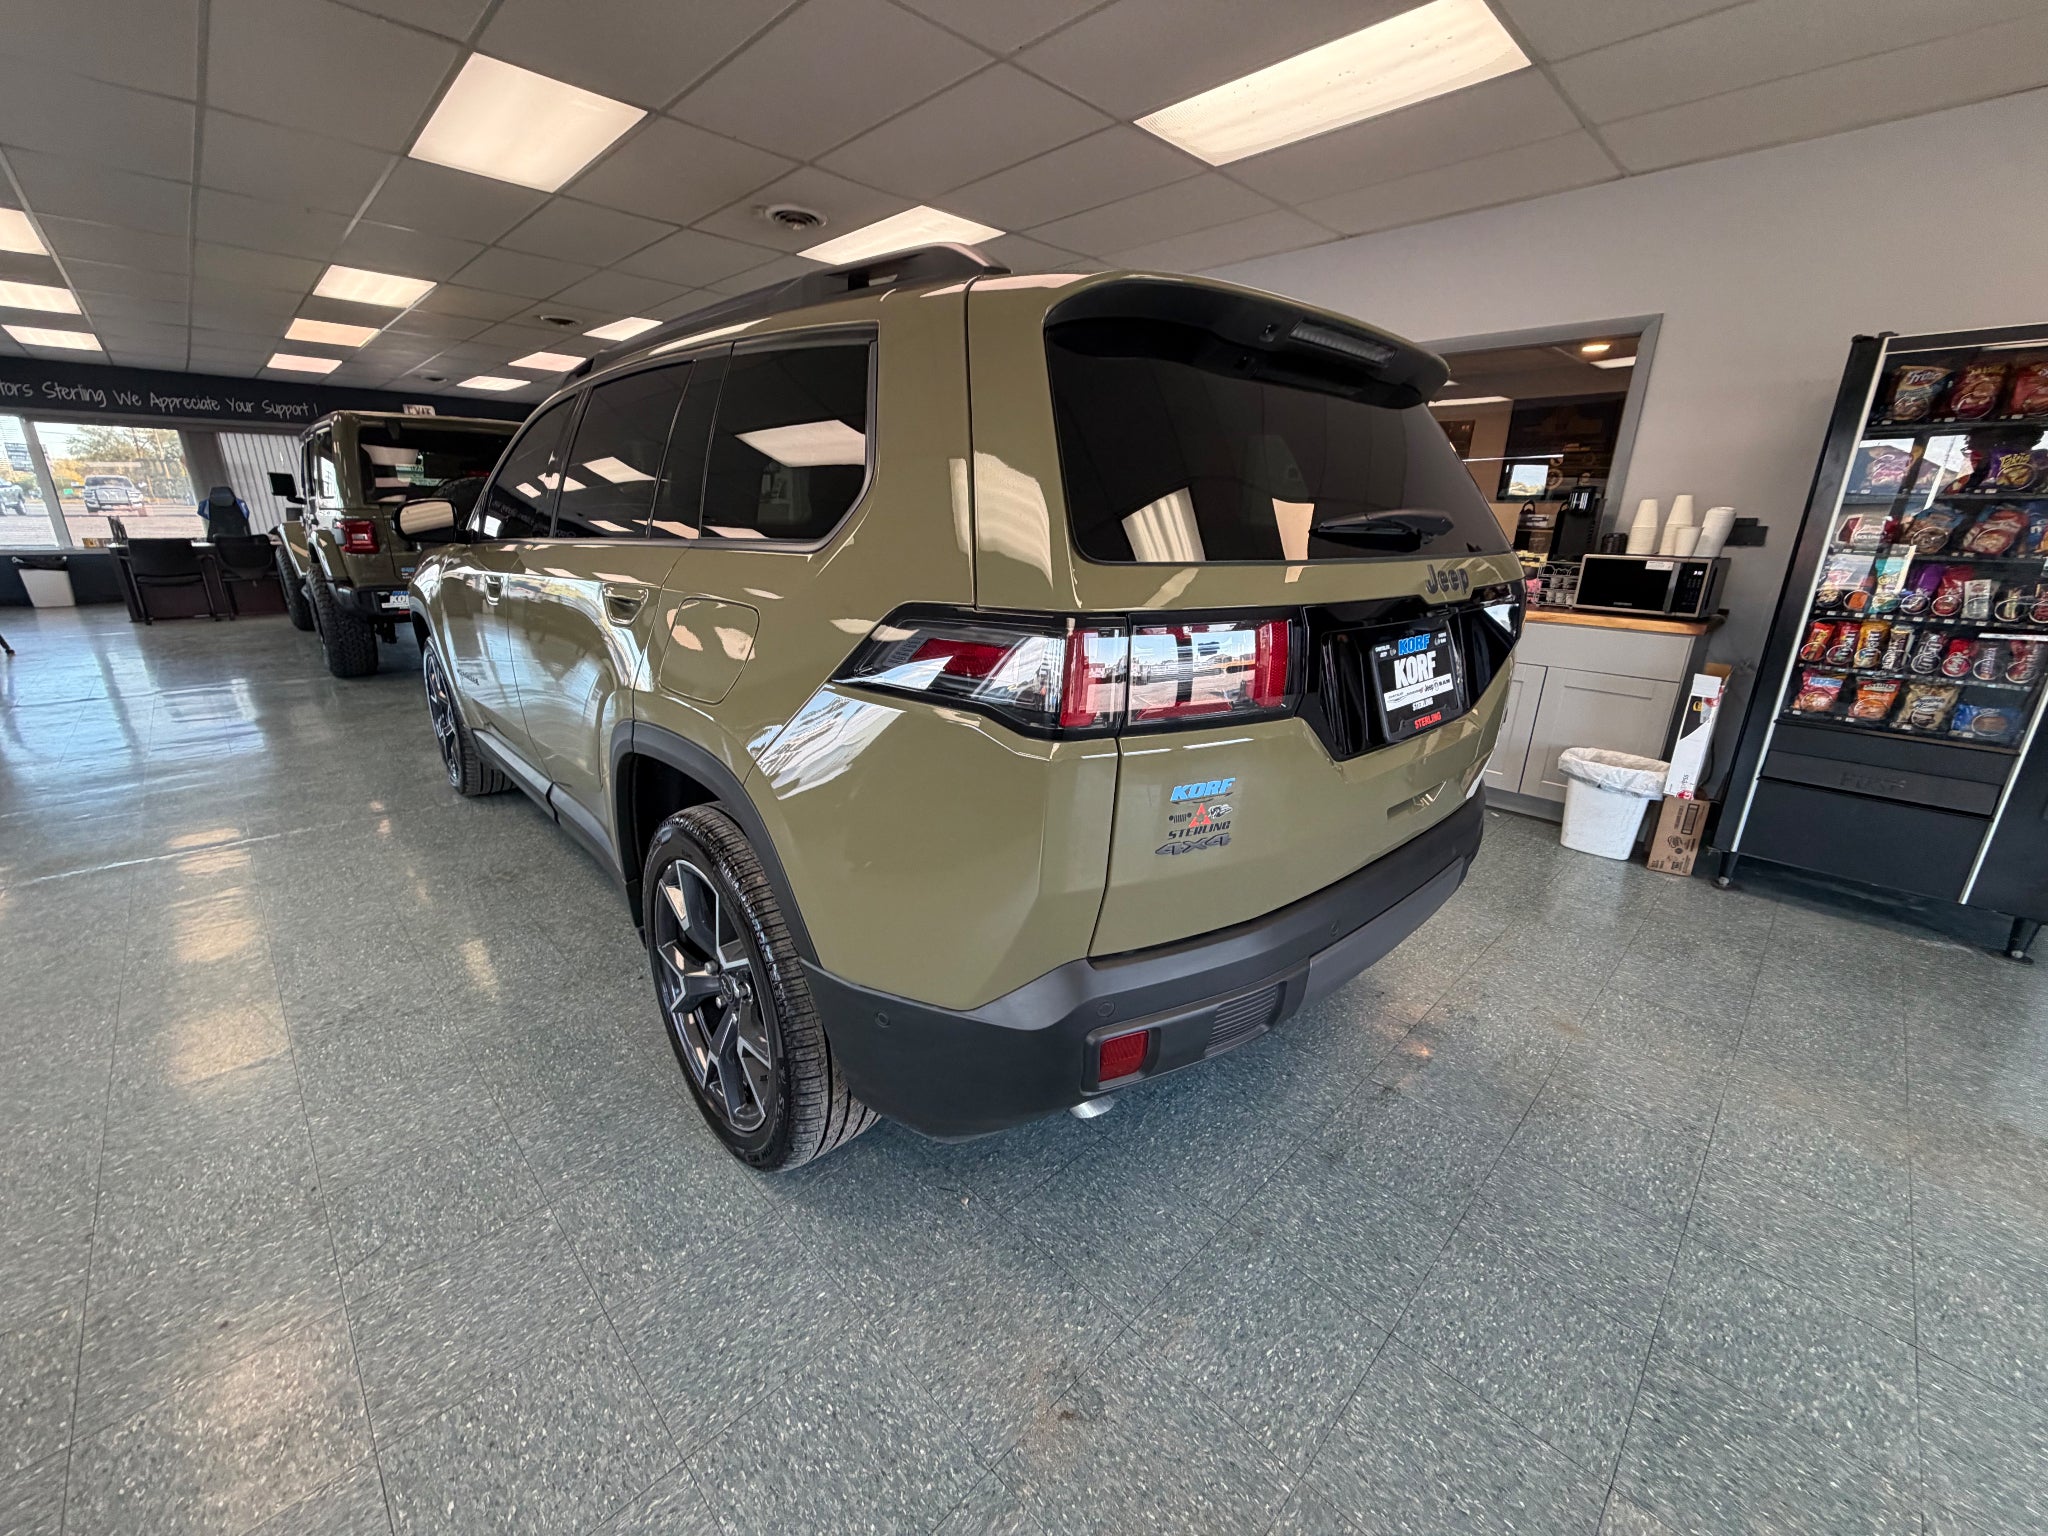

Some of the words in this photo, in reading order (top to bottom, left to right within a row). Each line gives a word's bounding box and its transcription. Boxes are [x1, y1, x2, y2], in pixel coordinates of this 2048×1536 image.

[42, 381, 107, 408] Sterling
[112, 389, 142, 407] We
[150, 391, 221, 414] Appreciate
[226, 397, 255, 413] Your
[1426, 563, 1469, 595] Jeep
[1398, 634, 1430, 655] KORF
[1394, 651, 1436, 689] KORF
[1414, 712, 1441, 729] STERLING
[1170, 777, 1235, 801] KORF
[1168, 820, 1231, 840] STERLING
